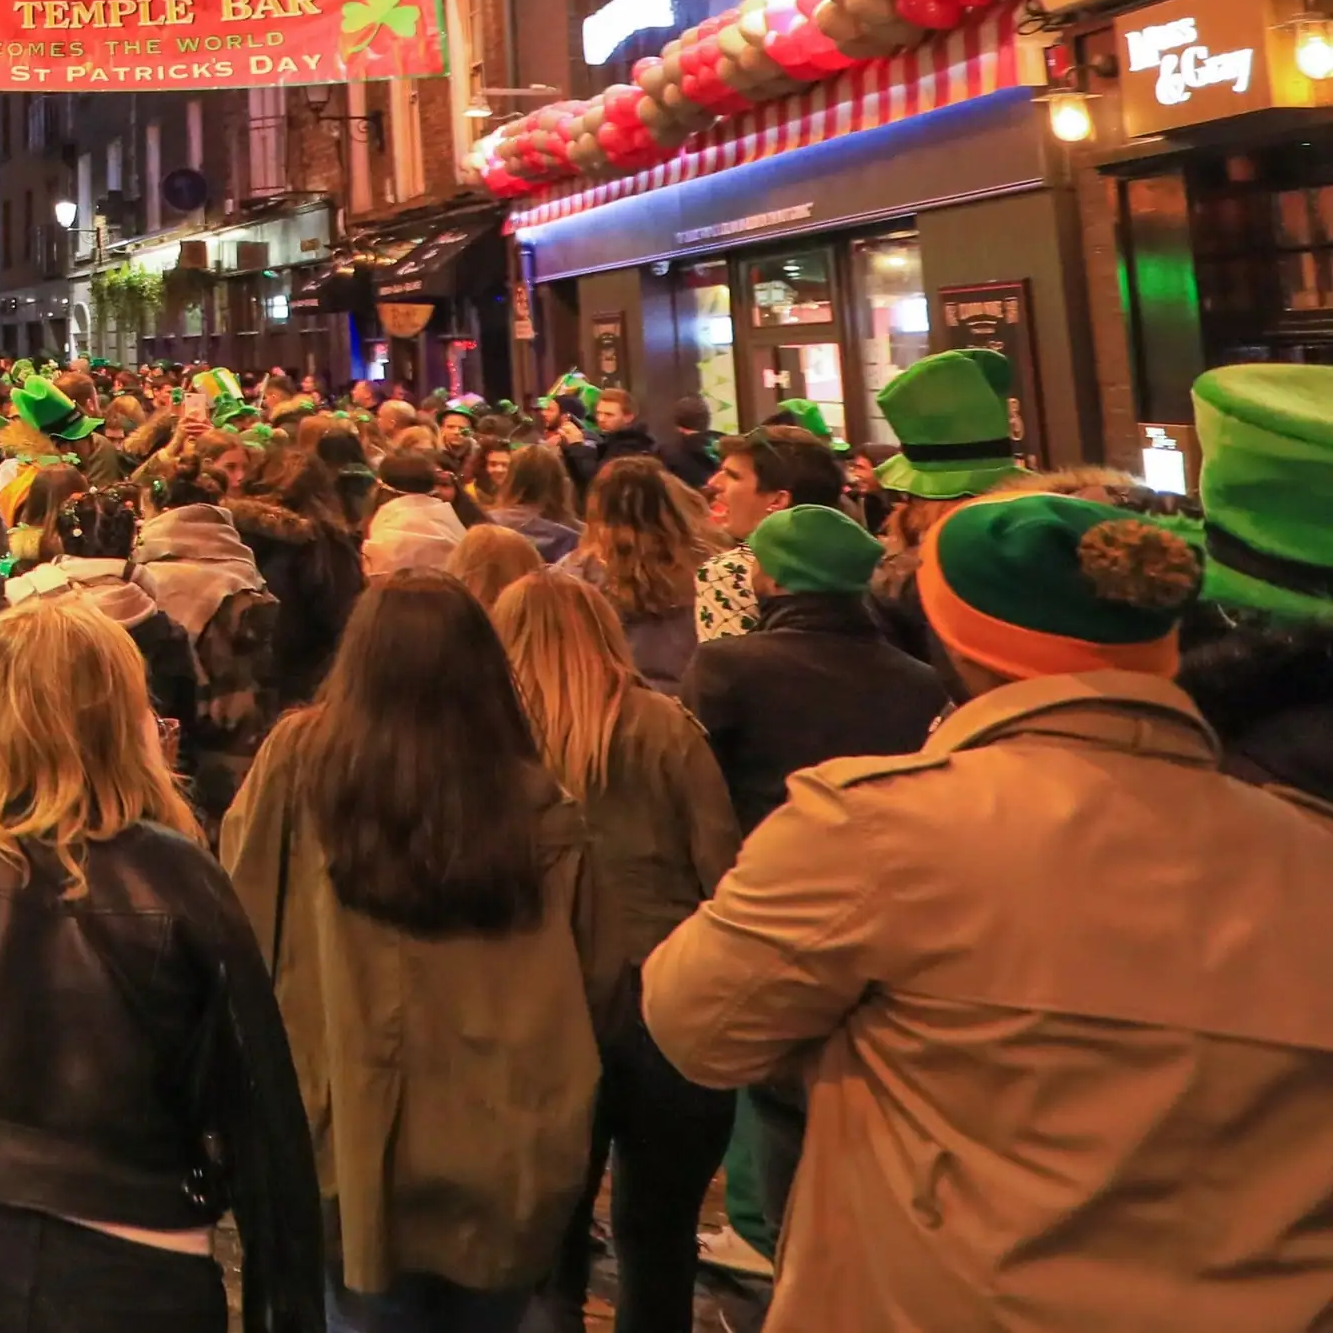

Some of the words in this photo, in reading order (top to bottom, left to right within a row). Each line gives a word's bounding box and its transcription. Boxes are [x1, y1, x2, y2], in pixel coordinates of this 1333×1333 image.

[105, 40, 161, 55] THE
[176, 32, 284, 53] WORLD
[66, 57, 233, 83] PATRICK'S
[249, 54, 322, 75] DAY
